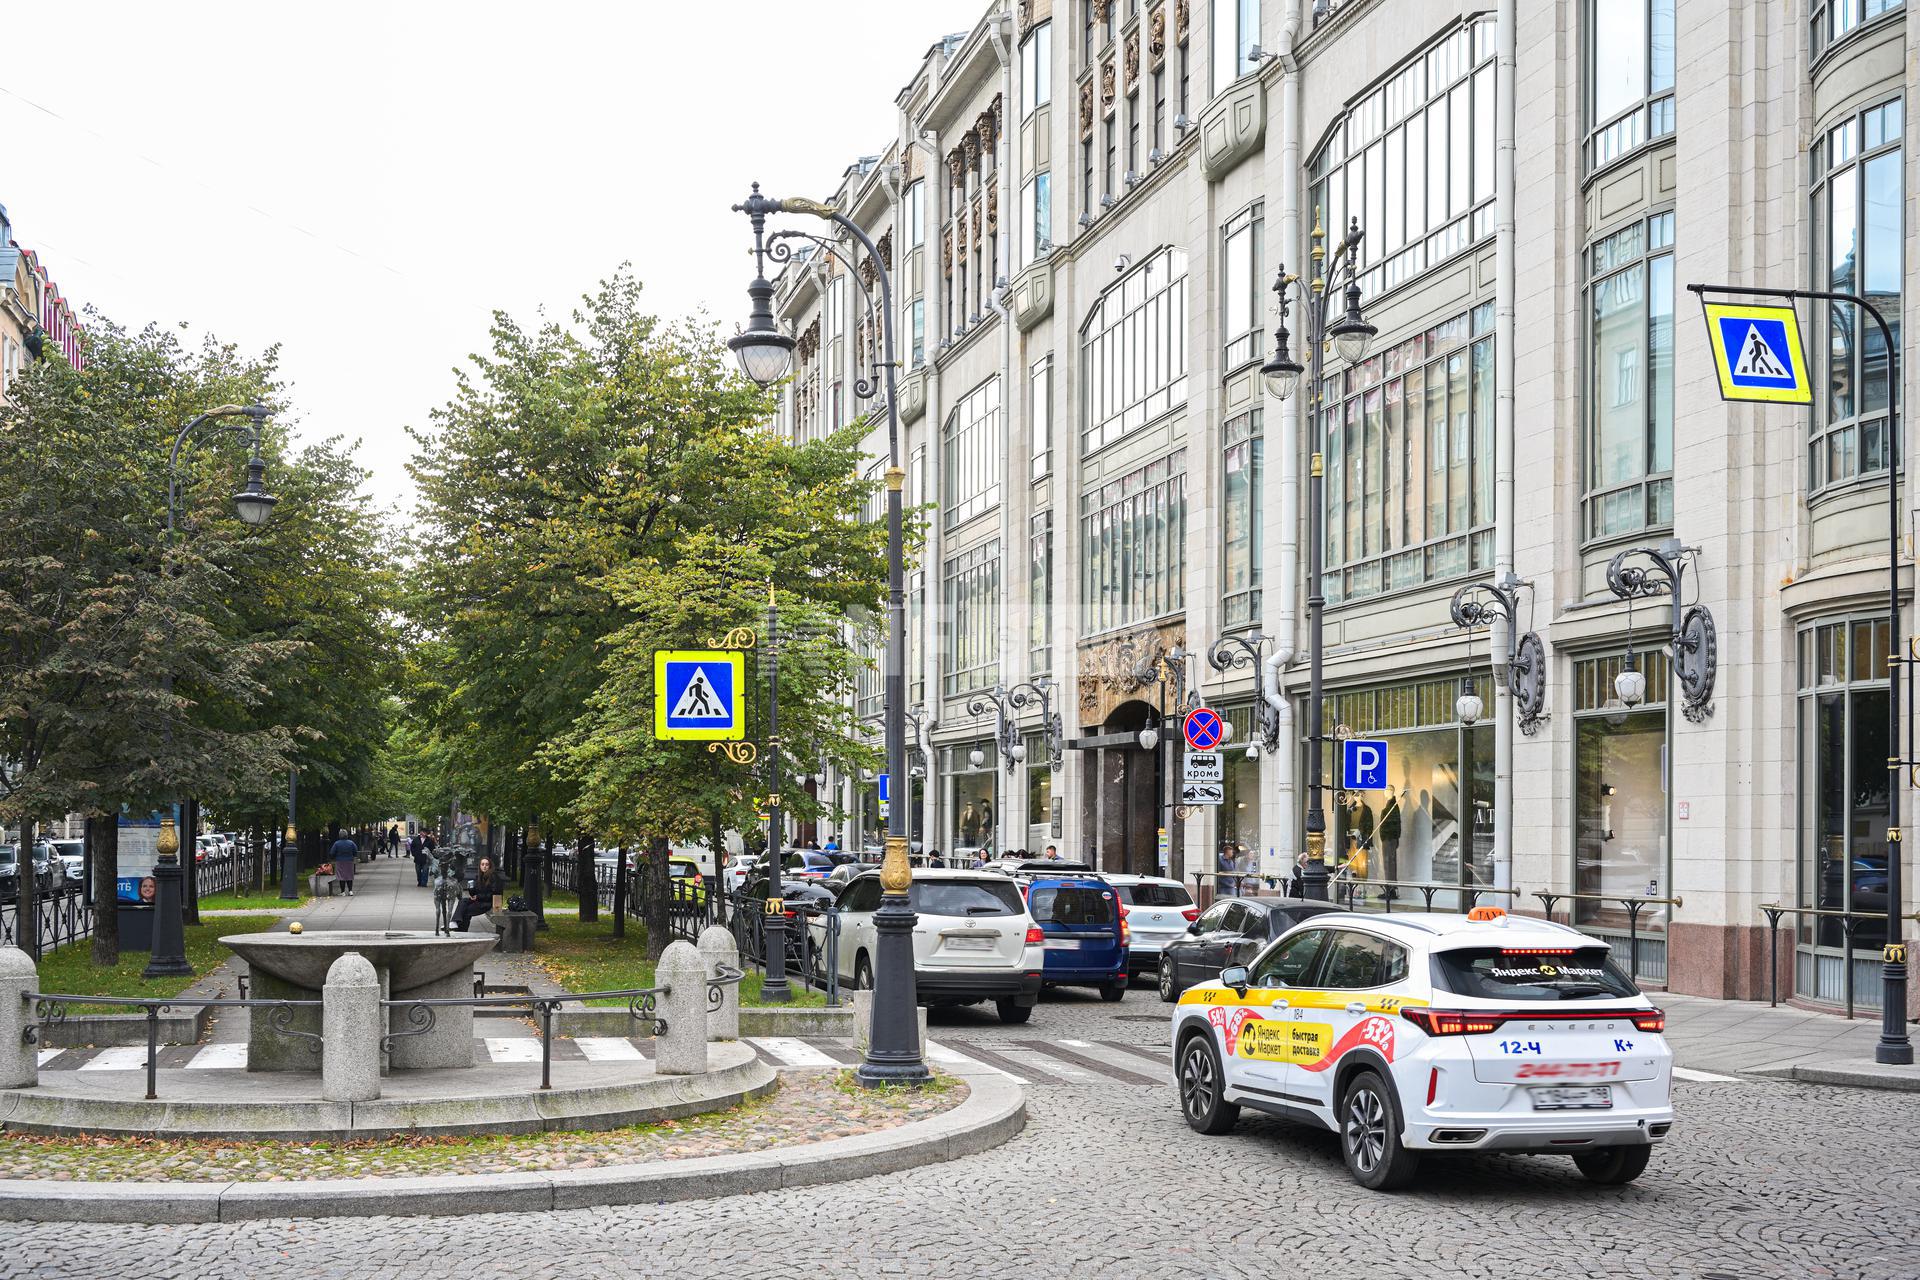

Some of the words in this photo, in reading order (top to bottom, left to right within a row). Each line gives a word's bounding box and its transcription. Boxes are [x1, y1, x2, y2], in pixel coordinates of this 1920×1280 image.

[1356, 746, 1380, 784] P
[1187, 770, 1220, 780] кроме
[1491, 967, 1541, 977] Яндекс
[1556, 966, 1605, 977] Маркет
[1294, 1008, 1304, 1020] 184
[1257, 1024, 1280, 1041] Яндекс
[1528, 1023, 1614, 1031] EXEED
[1291, 1028, 1319, 1043] быстрая
[1257, 1040, 1282, 1056] Маркет
[1292, 1045, 1320, 1057] доставка
